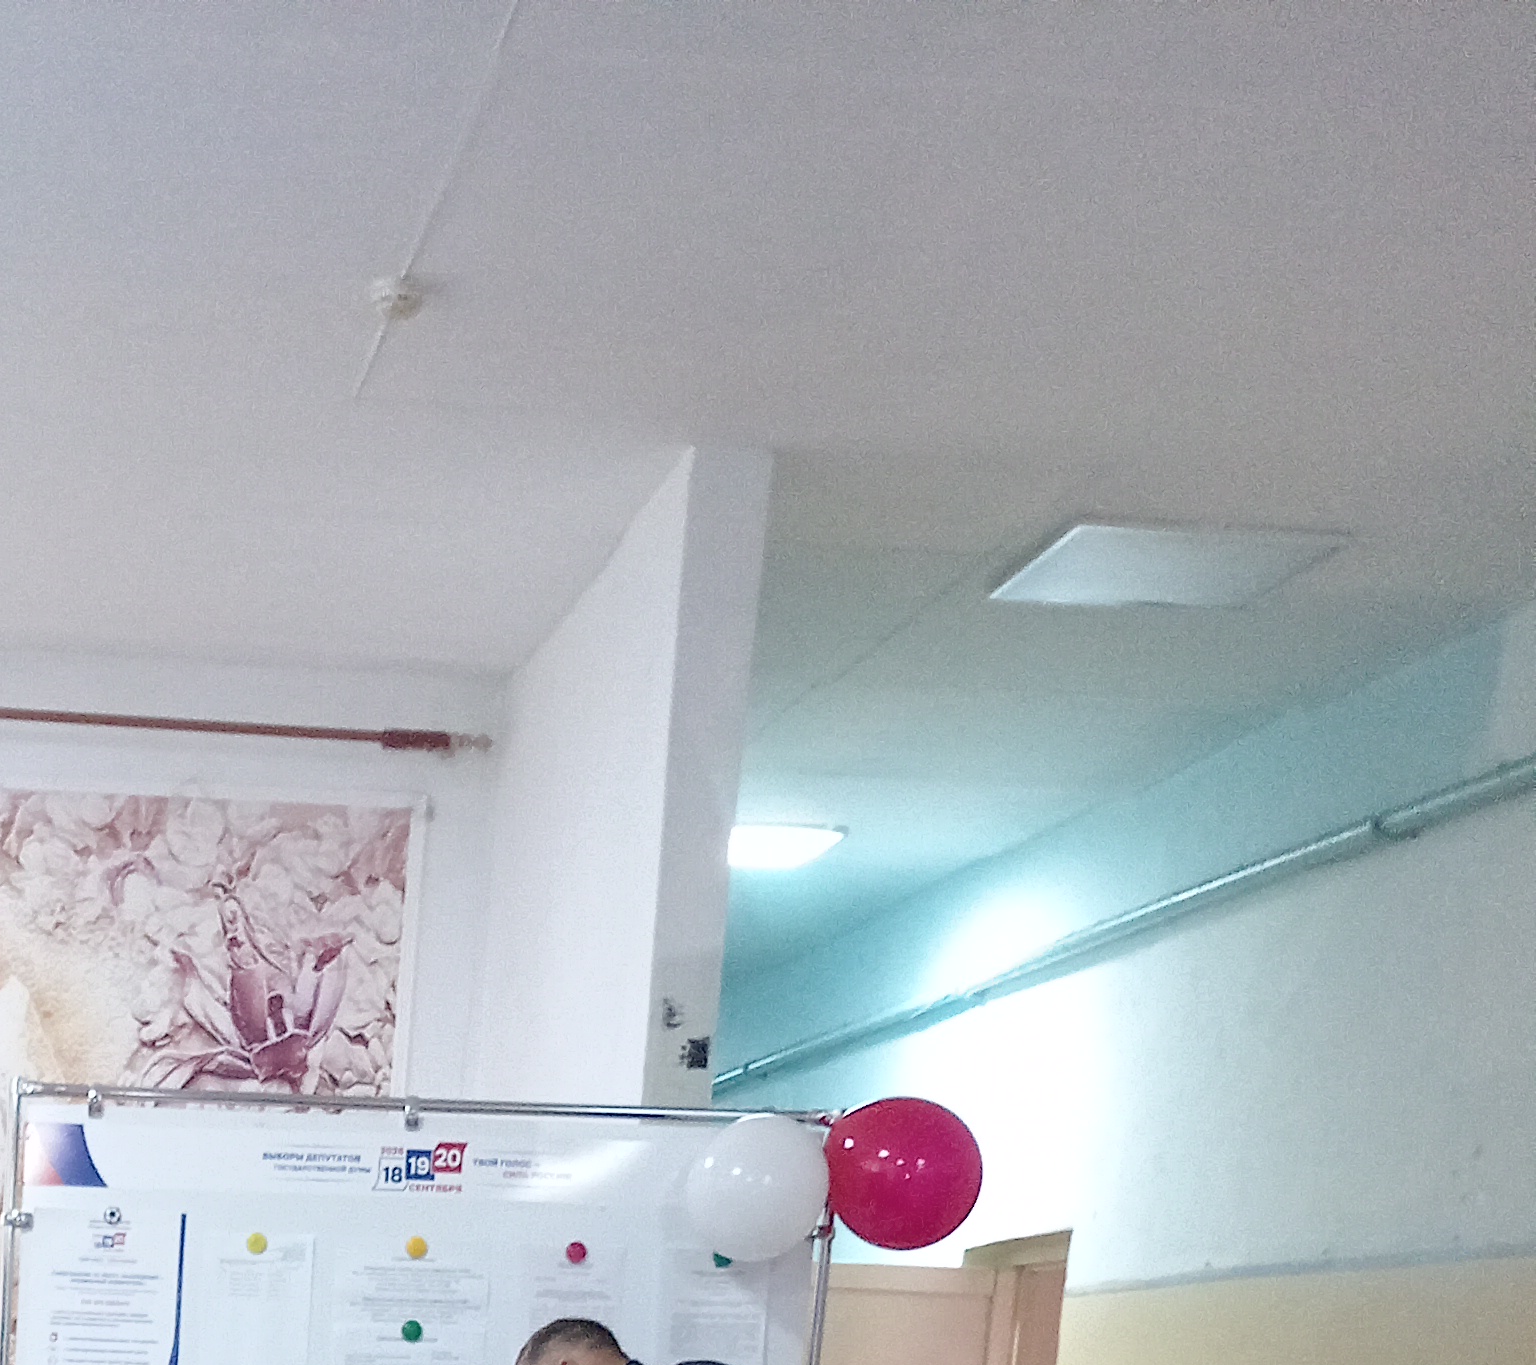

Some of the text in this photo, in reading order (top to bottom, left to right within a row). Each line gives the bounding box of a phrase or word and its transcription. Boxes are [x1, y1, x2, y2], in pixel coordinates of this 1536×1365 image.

[383, 1149, 461, 1183] 18 19 20
